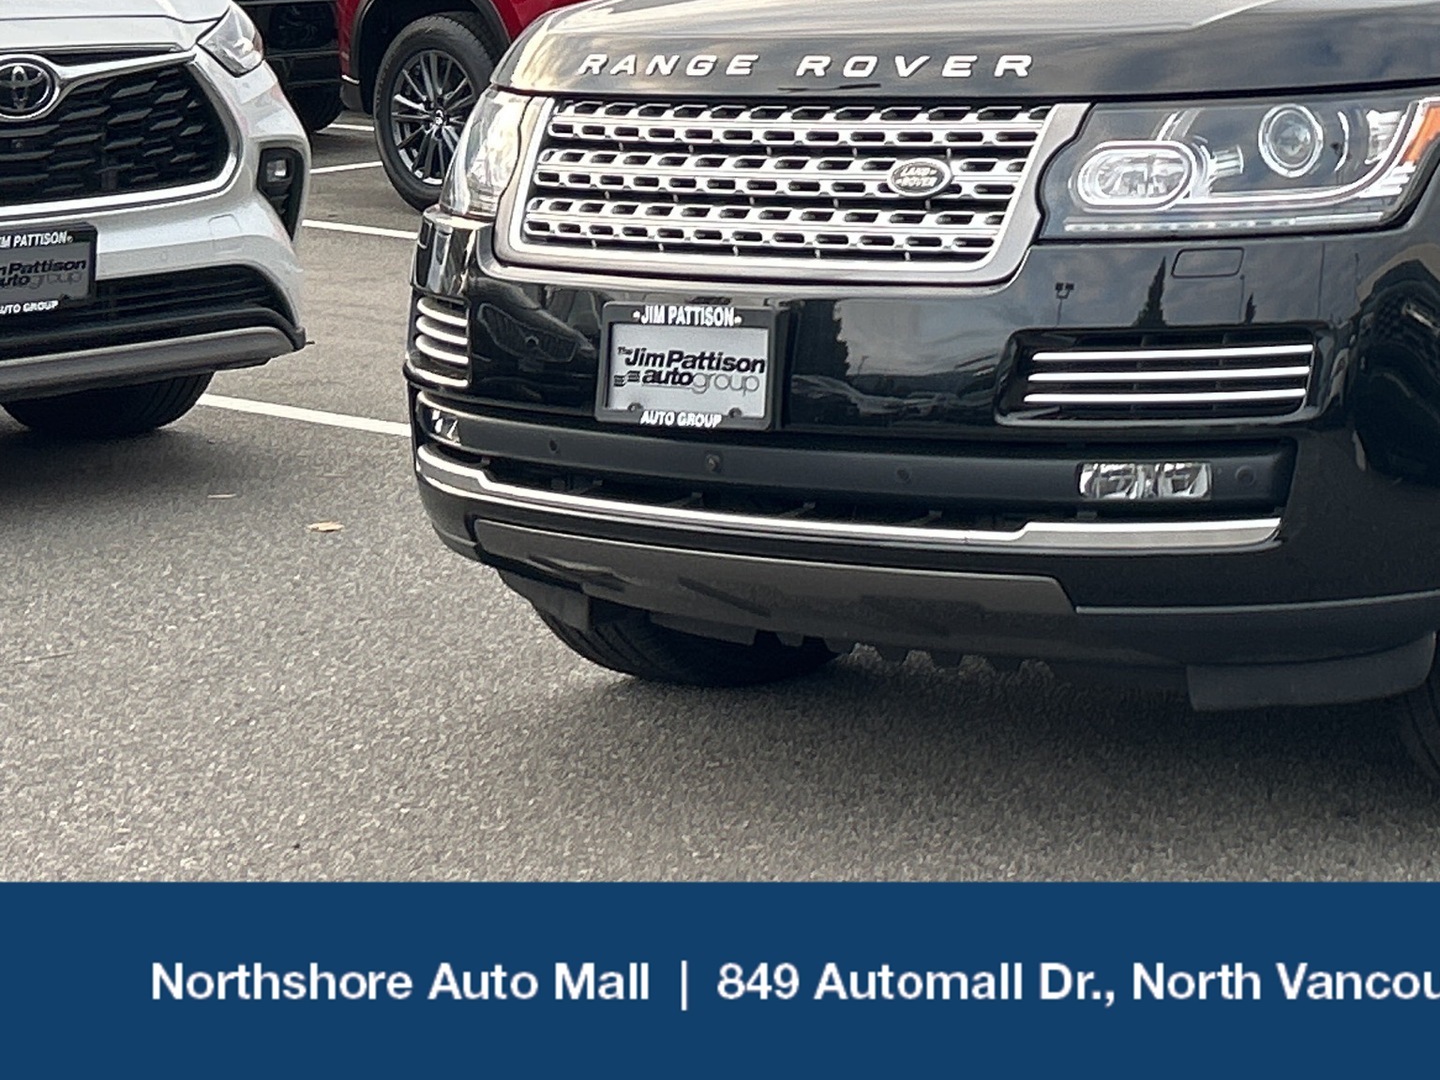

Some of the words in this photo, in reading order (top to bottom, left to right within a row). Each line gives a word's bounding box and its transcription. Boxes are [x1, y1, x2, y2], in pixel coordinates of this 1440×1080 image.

[576, 53, 758, 76] RANGE
[797, 54, 1033, 77] ROVER
[13, 231, 68, 247] PATTISON
[0, 304, 21, 314] UTO
[22, 300, 59, 312] GROUP
[641, 305, 665, 324] JIM
[668, 306, 734, 327] PATTISON
[640, 411, 675, 425] AUTO
[677, 412, 722, 428] GROUP
